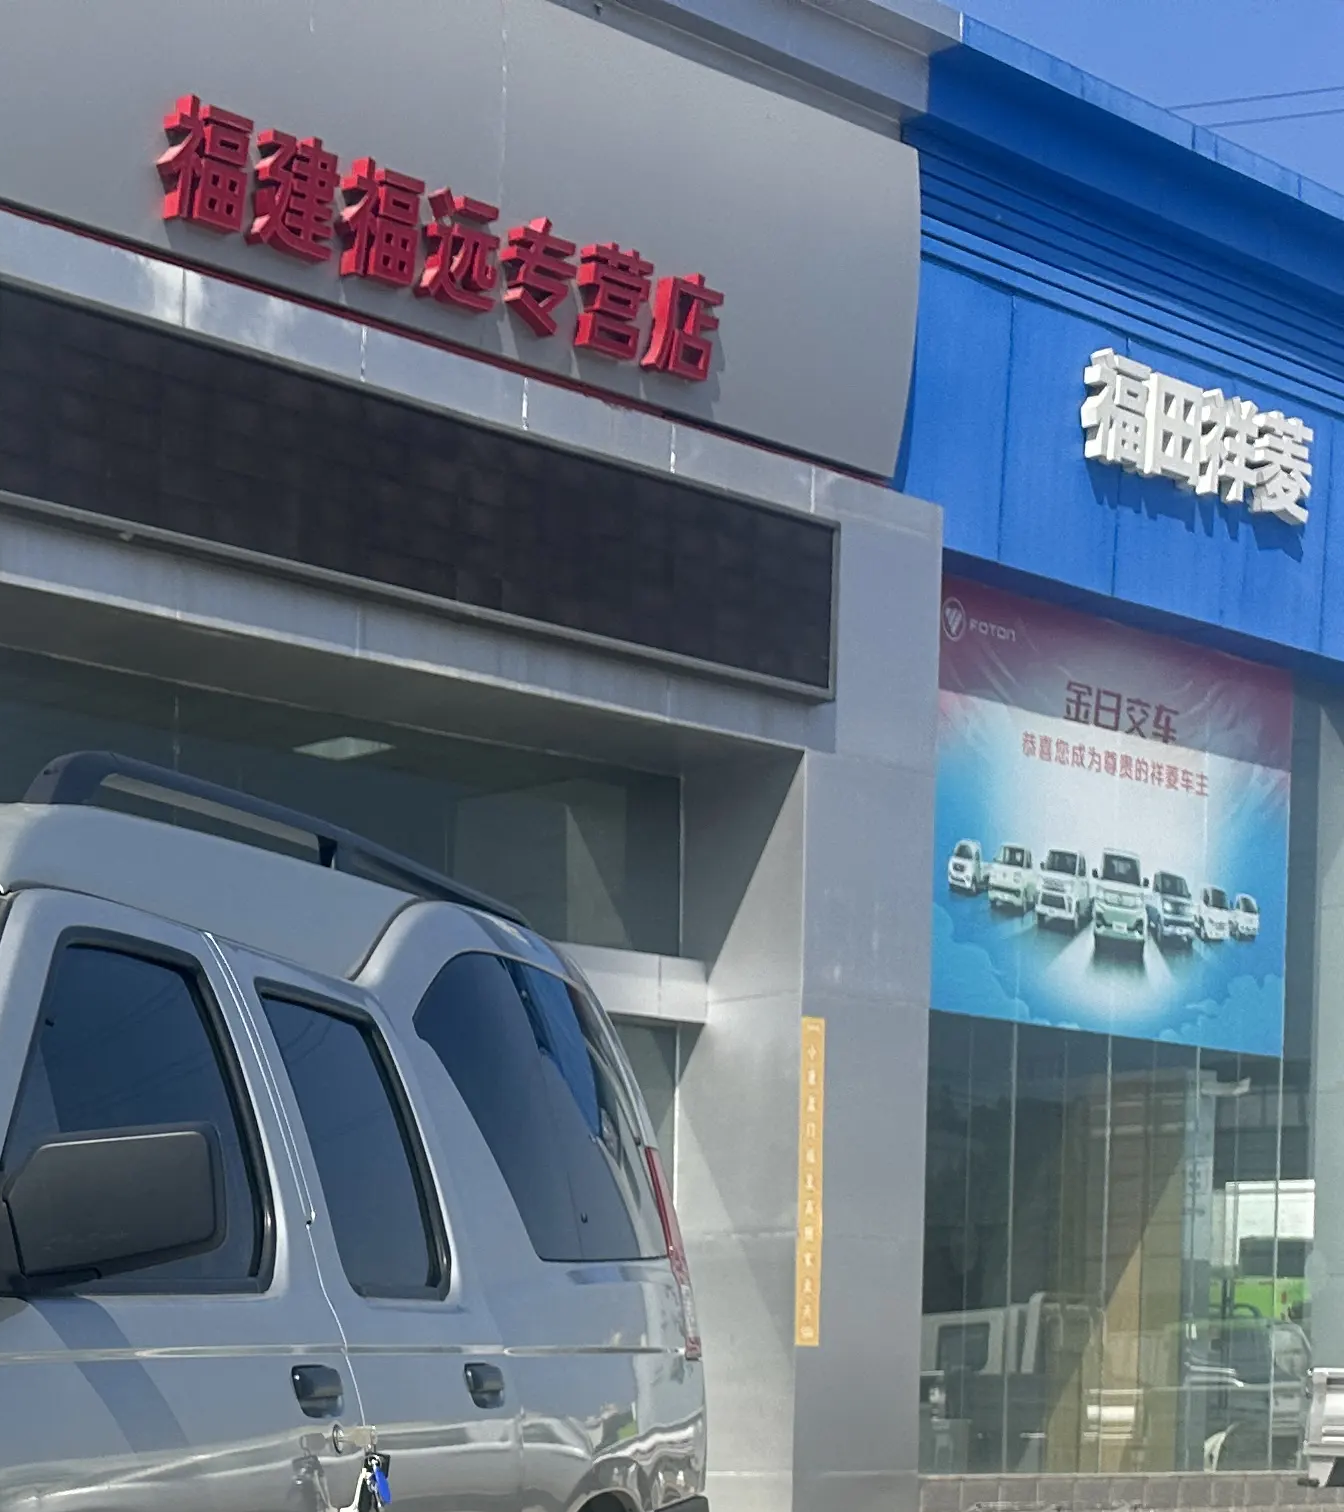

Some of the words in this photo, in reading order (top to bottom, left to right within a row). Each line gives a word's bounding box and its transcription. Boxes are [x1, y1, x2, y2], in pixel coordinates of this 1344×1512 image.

[156, 93, 724, 381] 福建福远专营店
[1080, 347, 1314, 526] 福田祥菱
[1063, 680, 1180, 745] 金日交车
